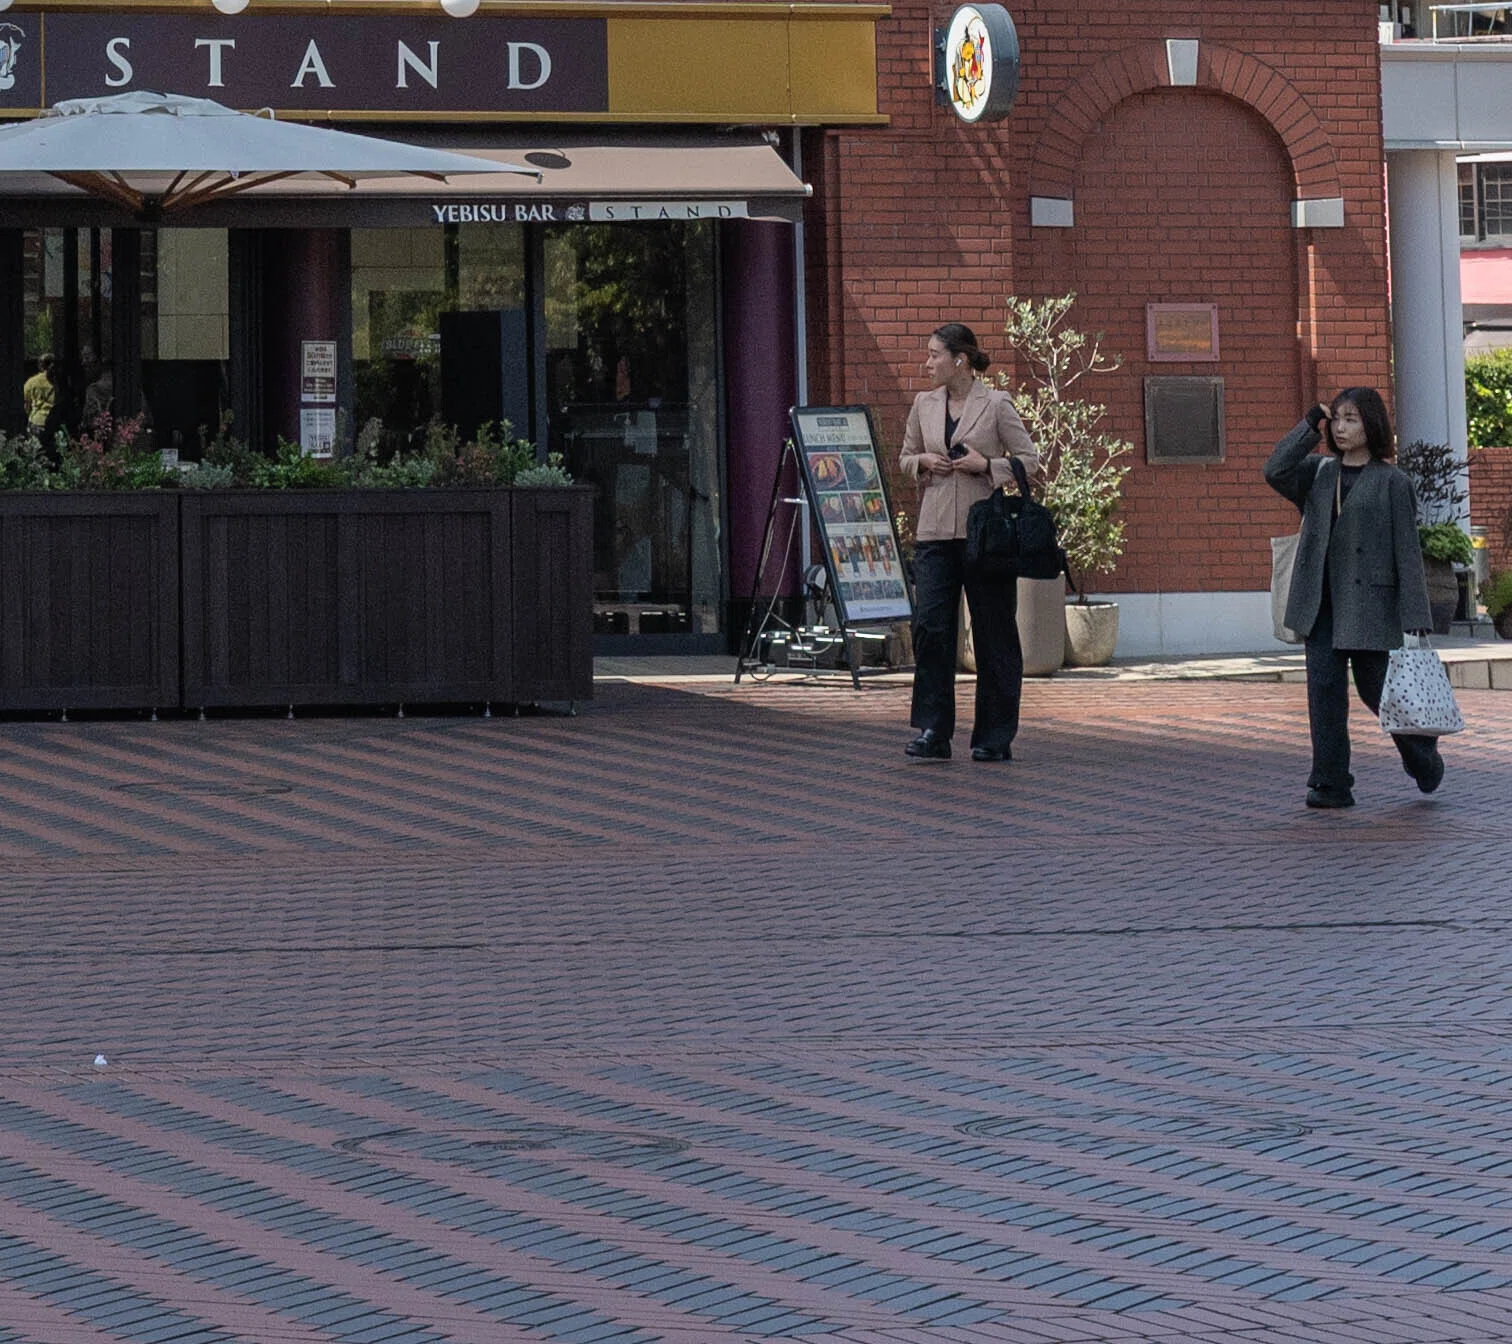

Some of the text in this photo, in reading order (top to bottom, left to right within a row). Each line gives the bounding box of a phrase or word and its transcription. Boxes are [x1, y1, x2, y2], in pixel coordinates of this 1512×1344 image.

[104, 37, 552, 90] STAND
[432, 204, 557, 222] YEBISU BAR
[606, 205, 732, 219] STAND
